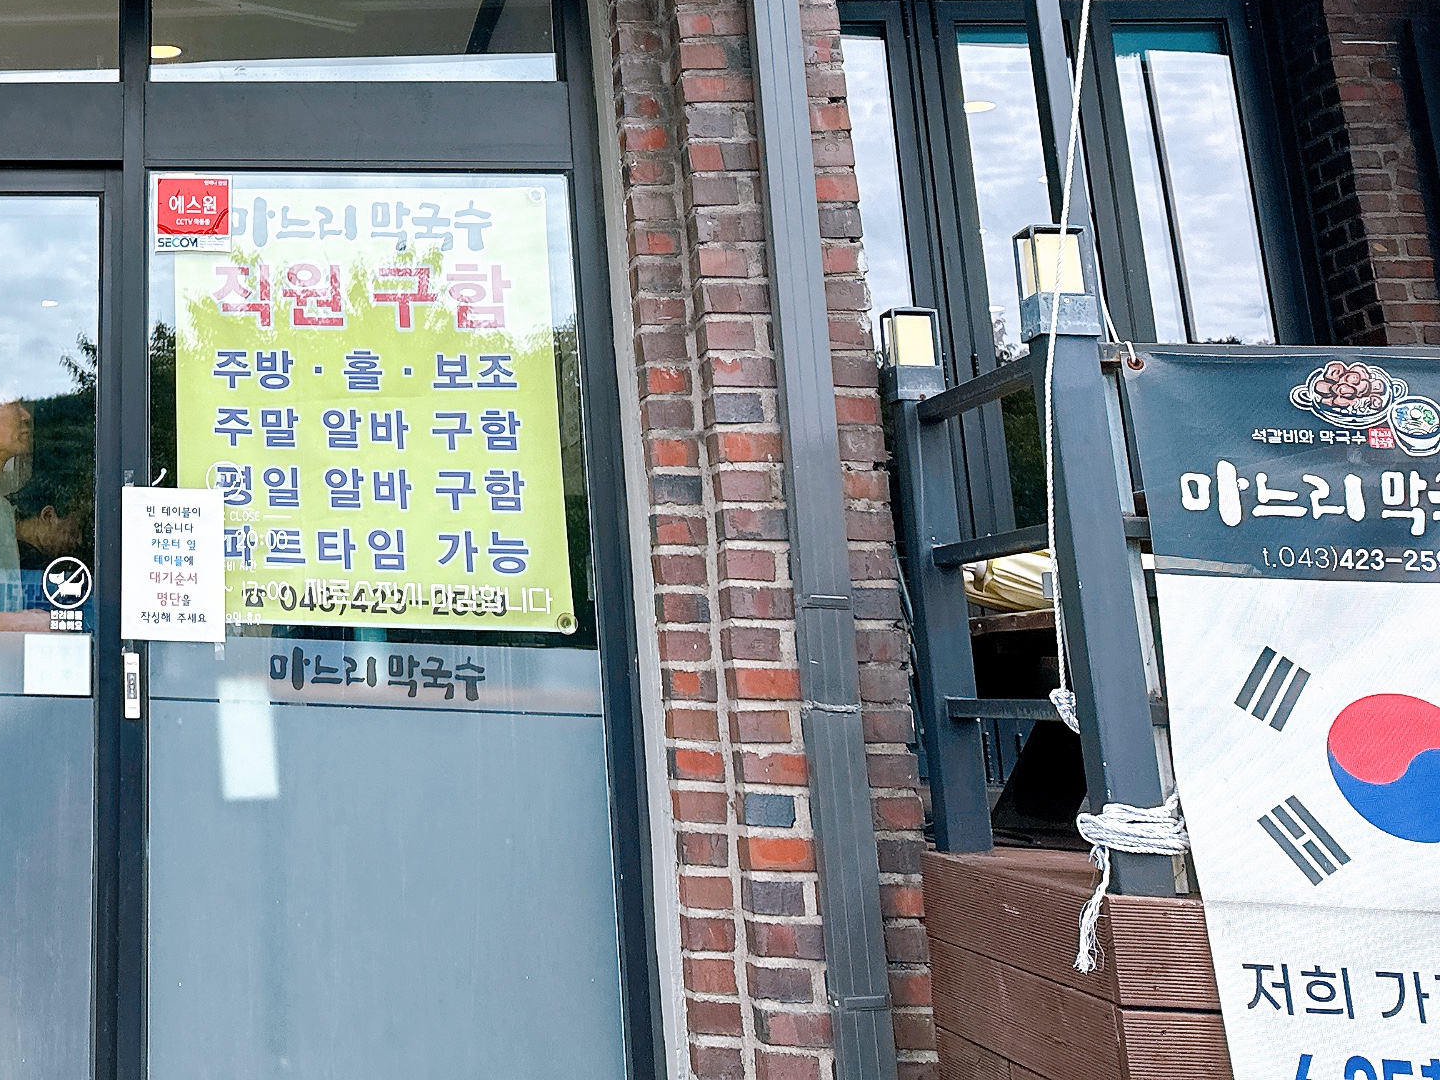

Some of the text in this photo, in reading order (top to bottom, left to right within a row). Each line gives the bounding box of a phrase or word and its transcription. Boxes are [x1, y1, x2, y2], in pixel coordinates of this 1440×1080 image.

[168, 195, 218, 215] 에스원
[231, 196, 493, 253] 마느리 막국수
[157, 237, 199, 248] SECOM
[212, 263, 513, 329] 직원 구함
[212, 350, 295, 391] 주방
[342, 350, 383, 391] 홀
[432, 353, 519, 390] 보조
[213, 407, 522, 451] 주말 알바 구함
[1251, 428, 1367, 445] 석갈비와 막국수
[216, 466, 526, 512] 평일 알바 구함
[1179, 458, 1367, 528] 마느리
[146, 505, 201, 518] 빈 테이블이
[229, 511, 261, 522] CLOSE
[153, 522, 195, 534] 없습니다
[151, 538, 196, 551] 카운터 옆
[224, 525, 531, 575] 파트타임 가능
[235, 530, 288, 550] 20:00
[153, 555, 195, 567] 테이블에
[149, 571, 198, 586] 대기순서
[156, 592, 192, 607] 명단을
[176, 612, 208, 624] 주세요
[269, 646, 486, 702] 마느리 막국수
[1241, 963, 1440, 1024] 저희 가
